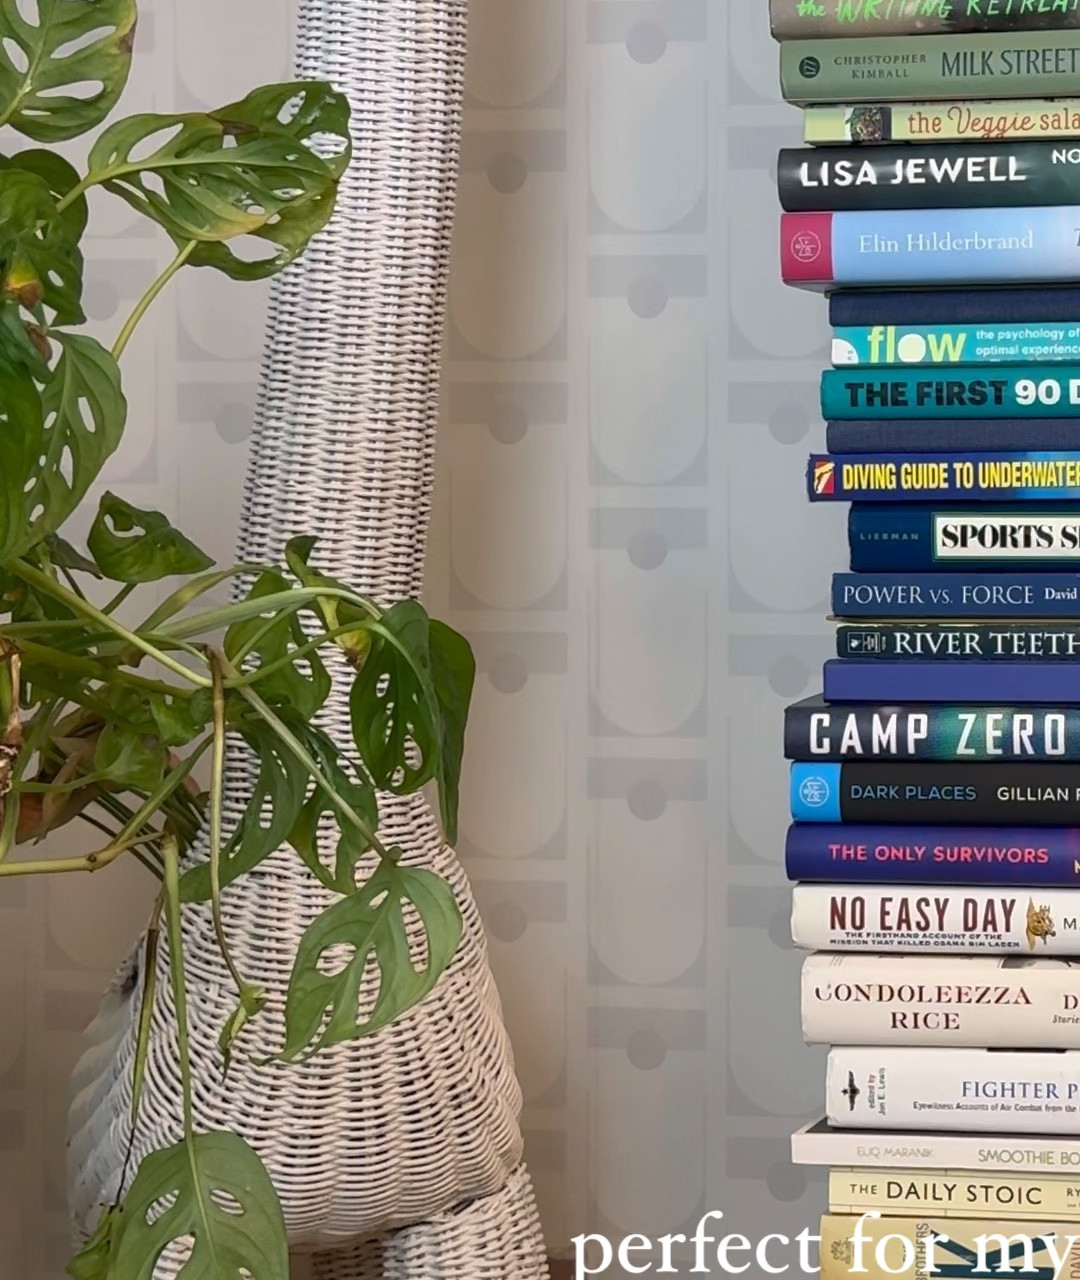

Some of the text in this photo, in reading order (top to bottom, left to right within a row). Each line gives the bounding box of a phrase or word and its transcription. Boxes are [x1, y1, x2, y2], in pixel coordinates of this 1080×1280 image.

[834, 54, 927, 66] CHRISTOPHER
[941, 47, 1080, 77] MILK STREET
[852, 68, 910, 79] KIMBALL
[908, 112, 942, 134] the
[947, 106, 1036, 139] Veggie
[800, 156, 1027, 187] LISA JEWELL
[867, 326, 966, 363] flow
[845, 382, 908, 407] THE
[916, 380, 1008, 406] FIRST
[1014, 379, 1061, 405] 90
[842, 463, 898, 490] DIVING
[901, 462, 949, 489] GUIDE
[953, 462, 974, 488] TO
[860, 533, 919, 541] LIEBMAN
[941, 524, 1053, 549] SPORTS
[893, 632, 984, 655] RIVER
[810, 713, 1065, 756] CAMP ZERO
[851, 785, 977, 800] DARK PLACES
[997, 786, 1069, 802] GILLIAN
[828, 844, 1049, 864] THE ONLY SURVIVORS
[830, 896, 1016, 933] NO EASY DAY
[815, 984, 1032, 1005] CONDOLEEZZA
[890, 1011, 960, 1030] RICE
[961, 1081, 1059, 1099] FIGHTER
[978, 1149, 1055, 1165] SMOOTHIE
[850, 1182, 1042, 1205] THE DAILY STOIC
